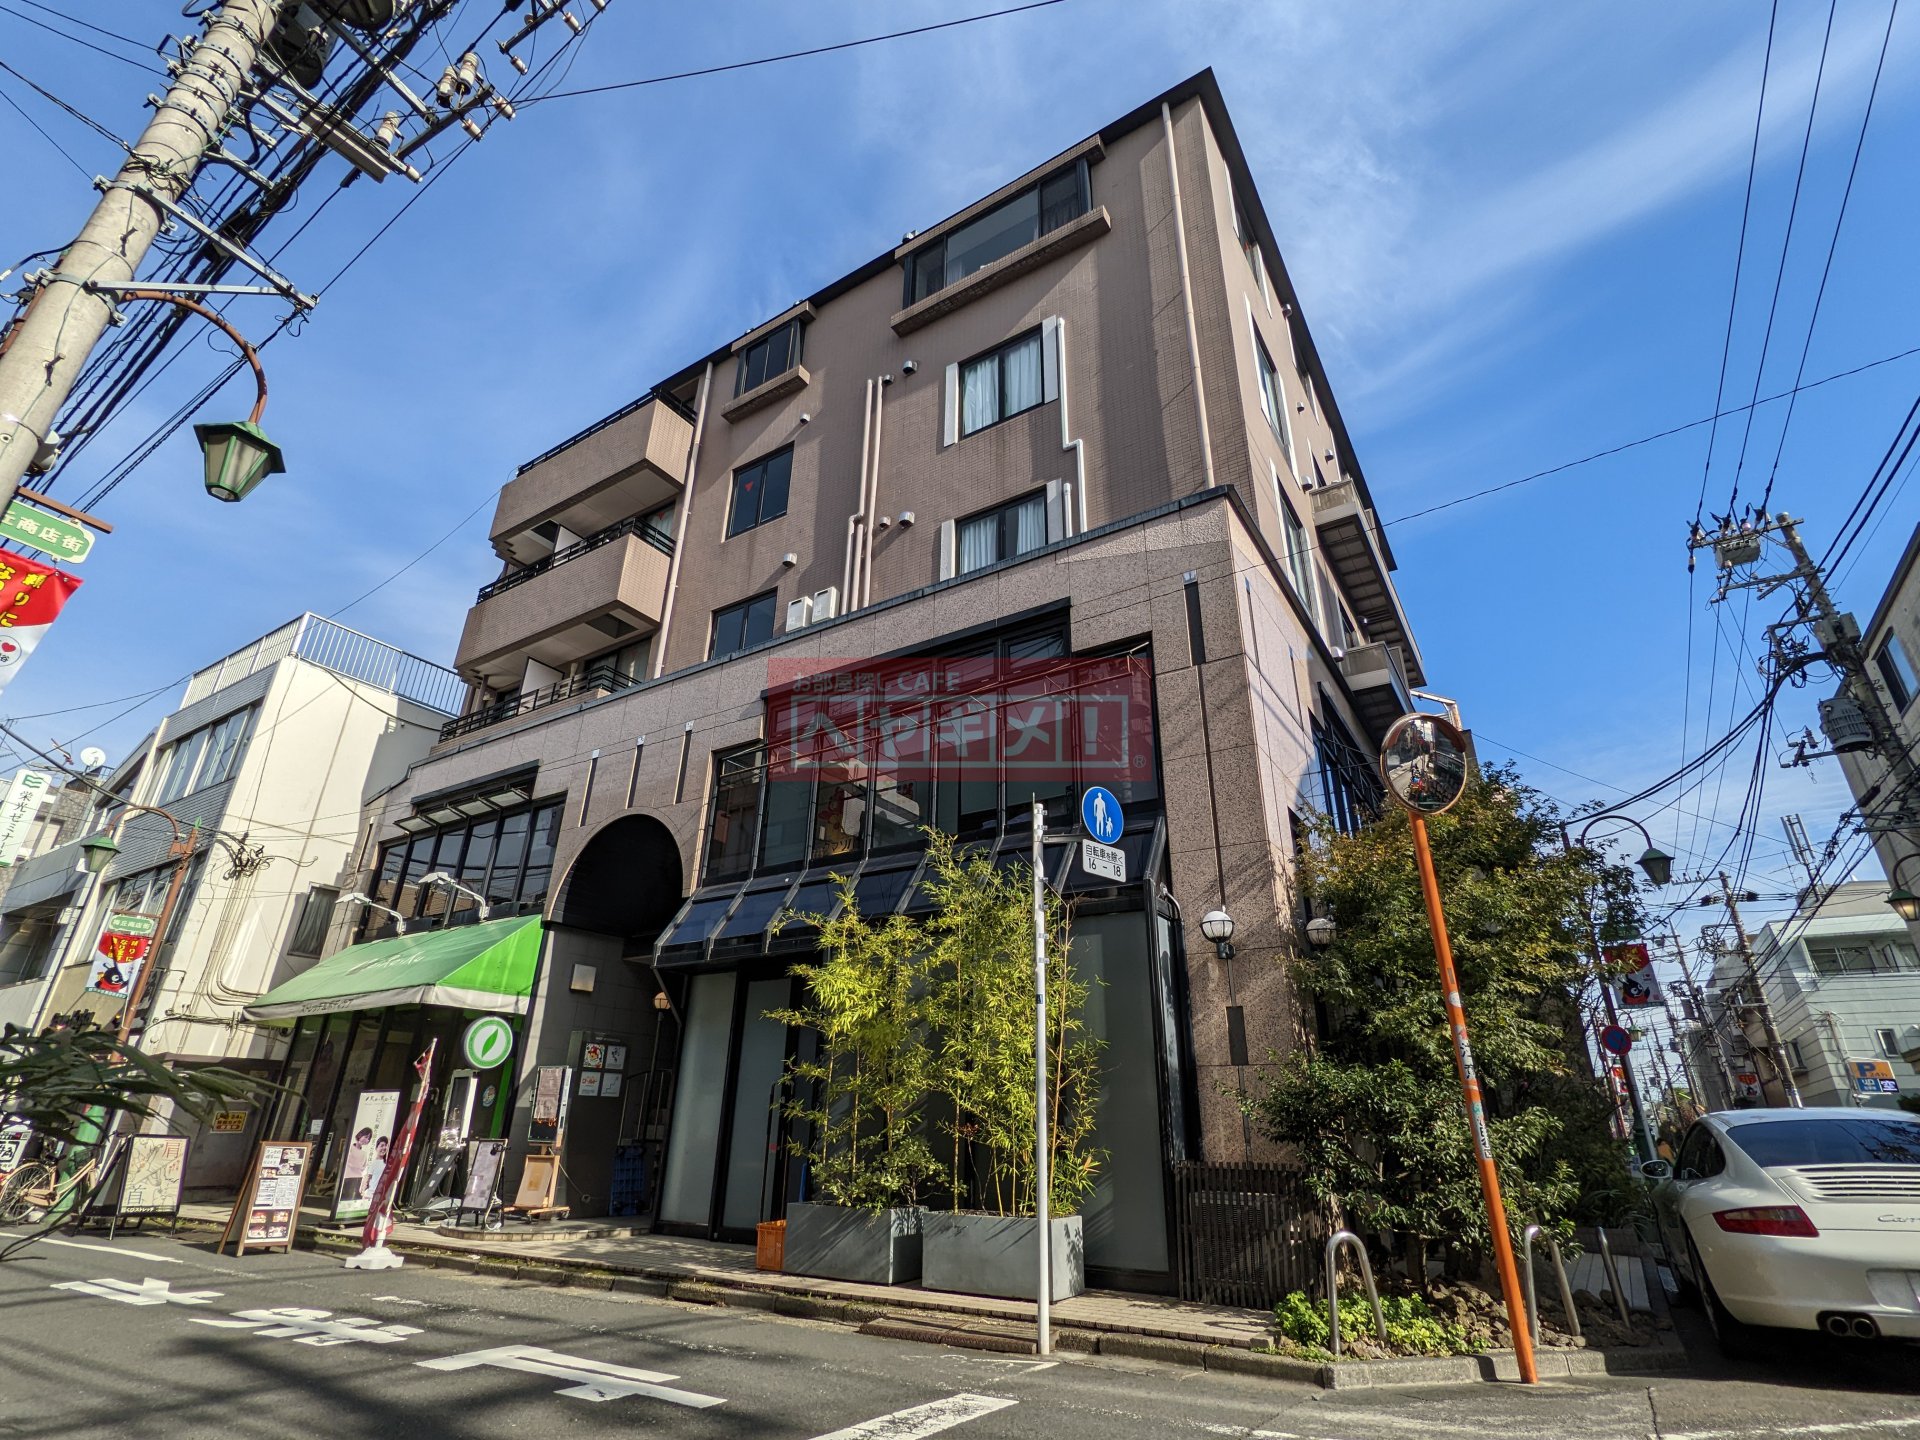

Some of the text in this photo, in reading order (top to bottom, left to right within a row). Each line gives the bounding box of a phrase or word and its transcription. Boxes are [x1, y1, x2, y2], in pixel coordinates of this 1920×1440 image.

[1086, 844, 1123, 864] 自転車を除く
[1088, 857, 1097, 870] 16
[1113, 864, 1122, 877] 18
[1856, 1062, 1876, 1077] P
[162, 1142, 181, 1158] 肩
[127, 1184, 147, 1206] 首
